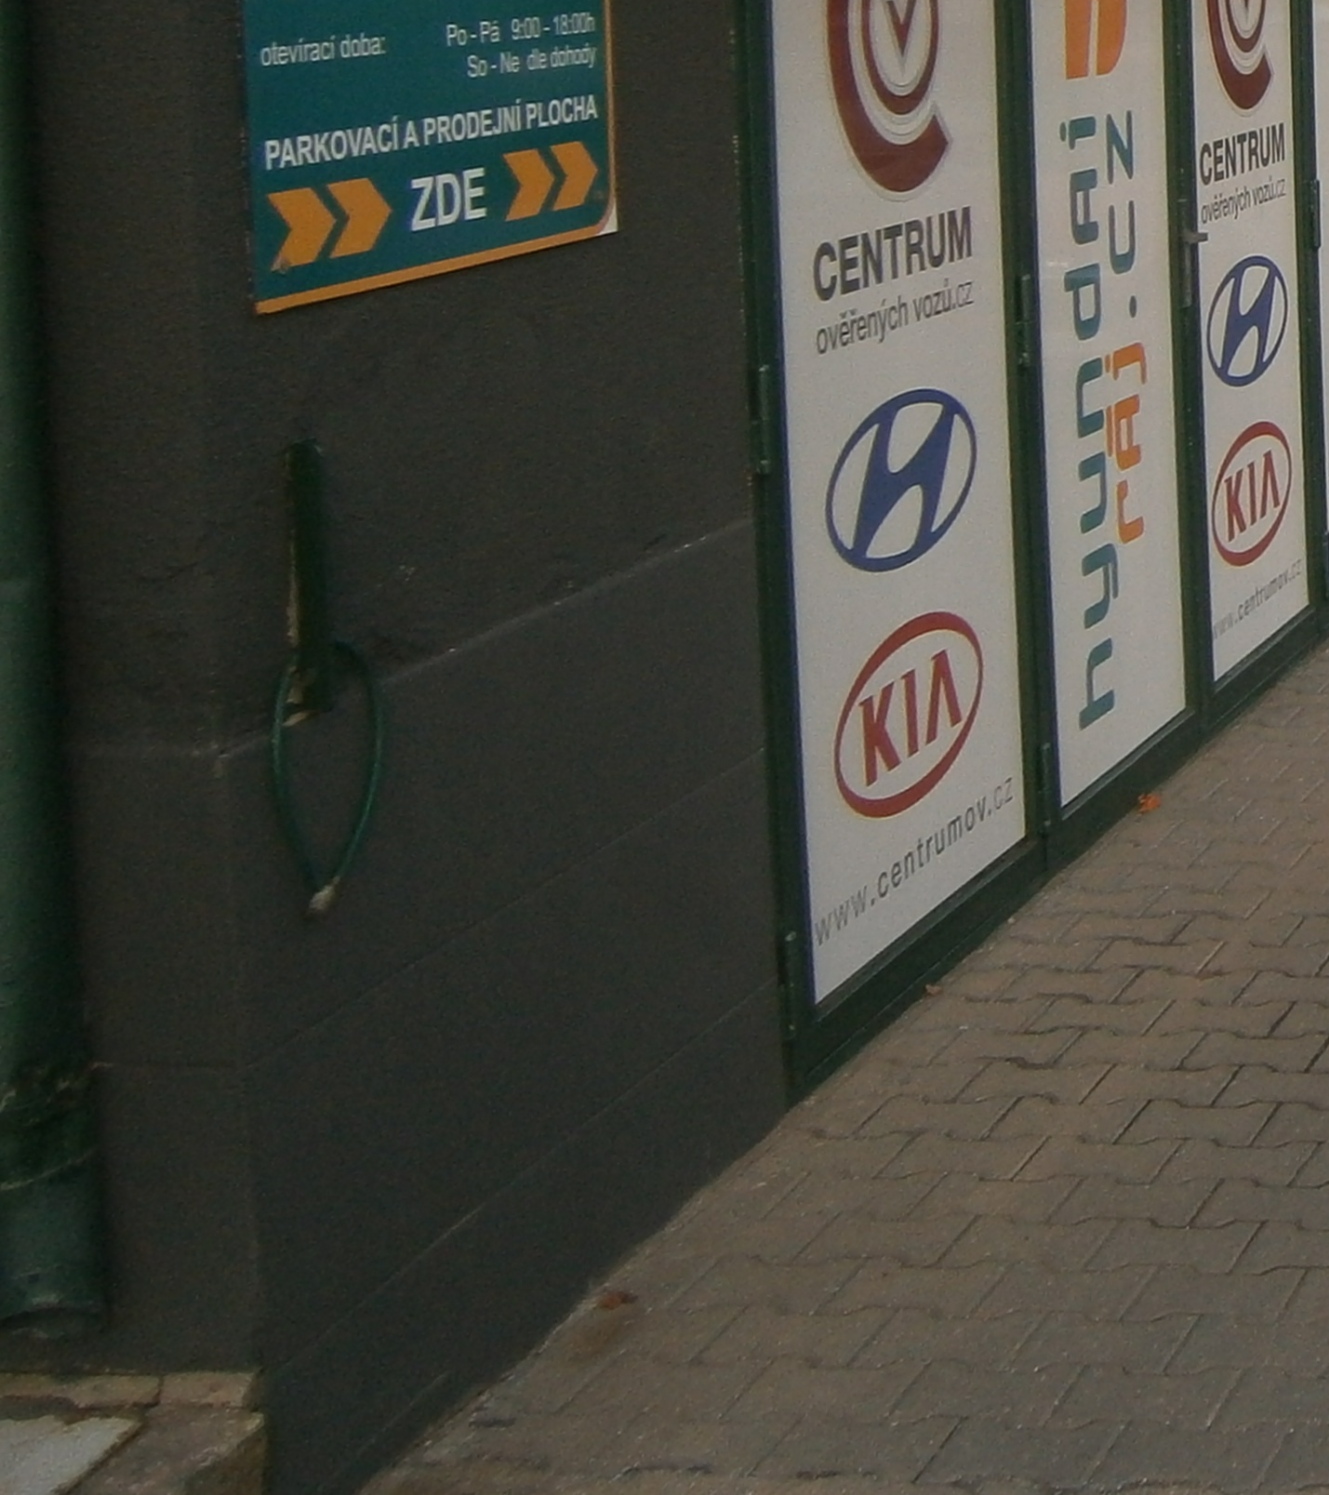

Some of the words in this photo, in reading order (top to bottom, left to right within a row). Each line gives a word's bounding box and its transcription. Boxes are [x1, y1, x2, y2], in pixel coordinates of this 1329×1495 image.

[261, 34, 335, 66] otevírací
[340, 33, 386, 59] doba:
[446, 23, 467, 47] Po
[479, 20, 501, 43] Pá
[511, 16, 541, 40] 9:00
[467, 54, 488, 78] So
[500, 51, 521, 74] Ne
[526, 48, 548, 70] dle
[550, 43, 598, 69] dohody
[265, 116, 400, 170] PARKOVACÍ
[404, 119, 420, 149] A
[423, 98, 522, 144] PRODEJNÍ
[526, 95, 599, 130] PLOCHA
[1200, 122, 1286, 186] CENTRUM
[411, 167, 488, 232] ZDE
[813, 206, 973, 303] CENTRUM
[815, 295, 909, 356] ověřených
[913, 278, 975, 325] vozů.cz
[1223, 449, 1281, 543] KIA
[859, 647, 964, 788] KIA
[814, 774, 1014, 948] www.centrumov.cz
